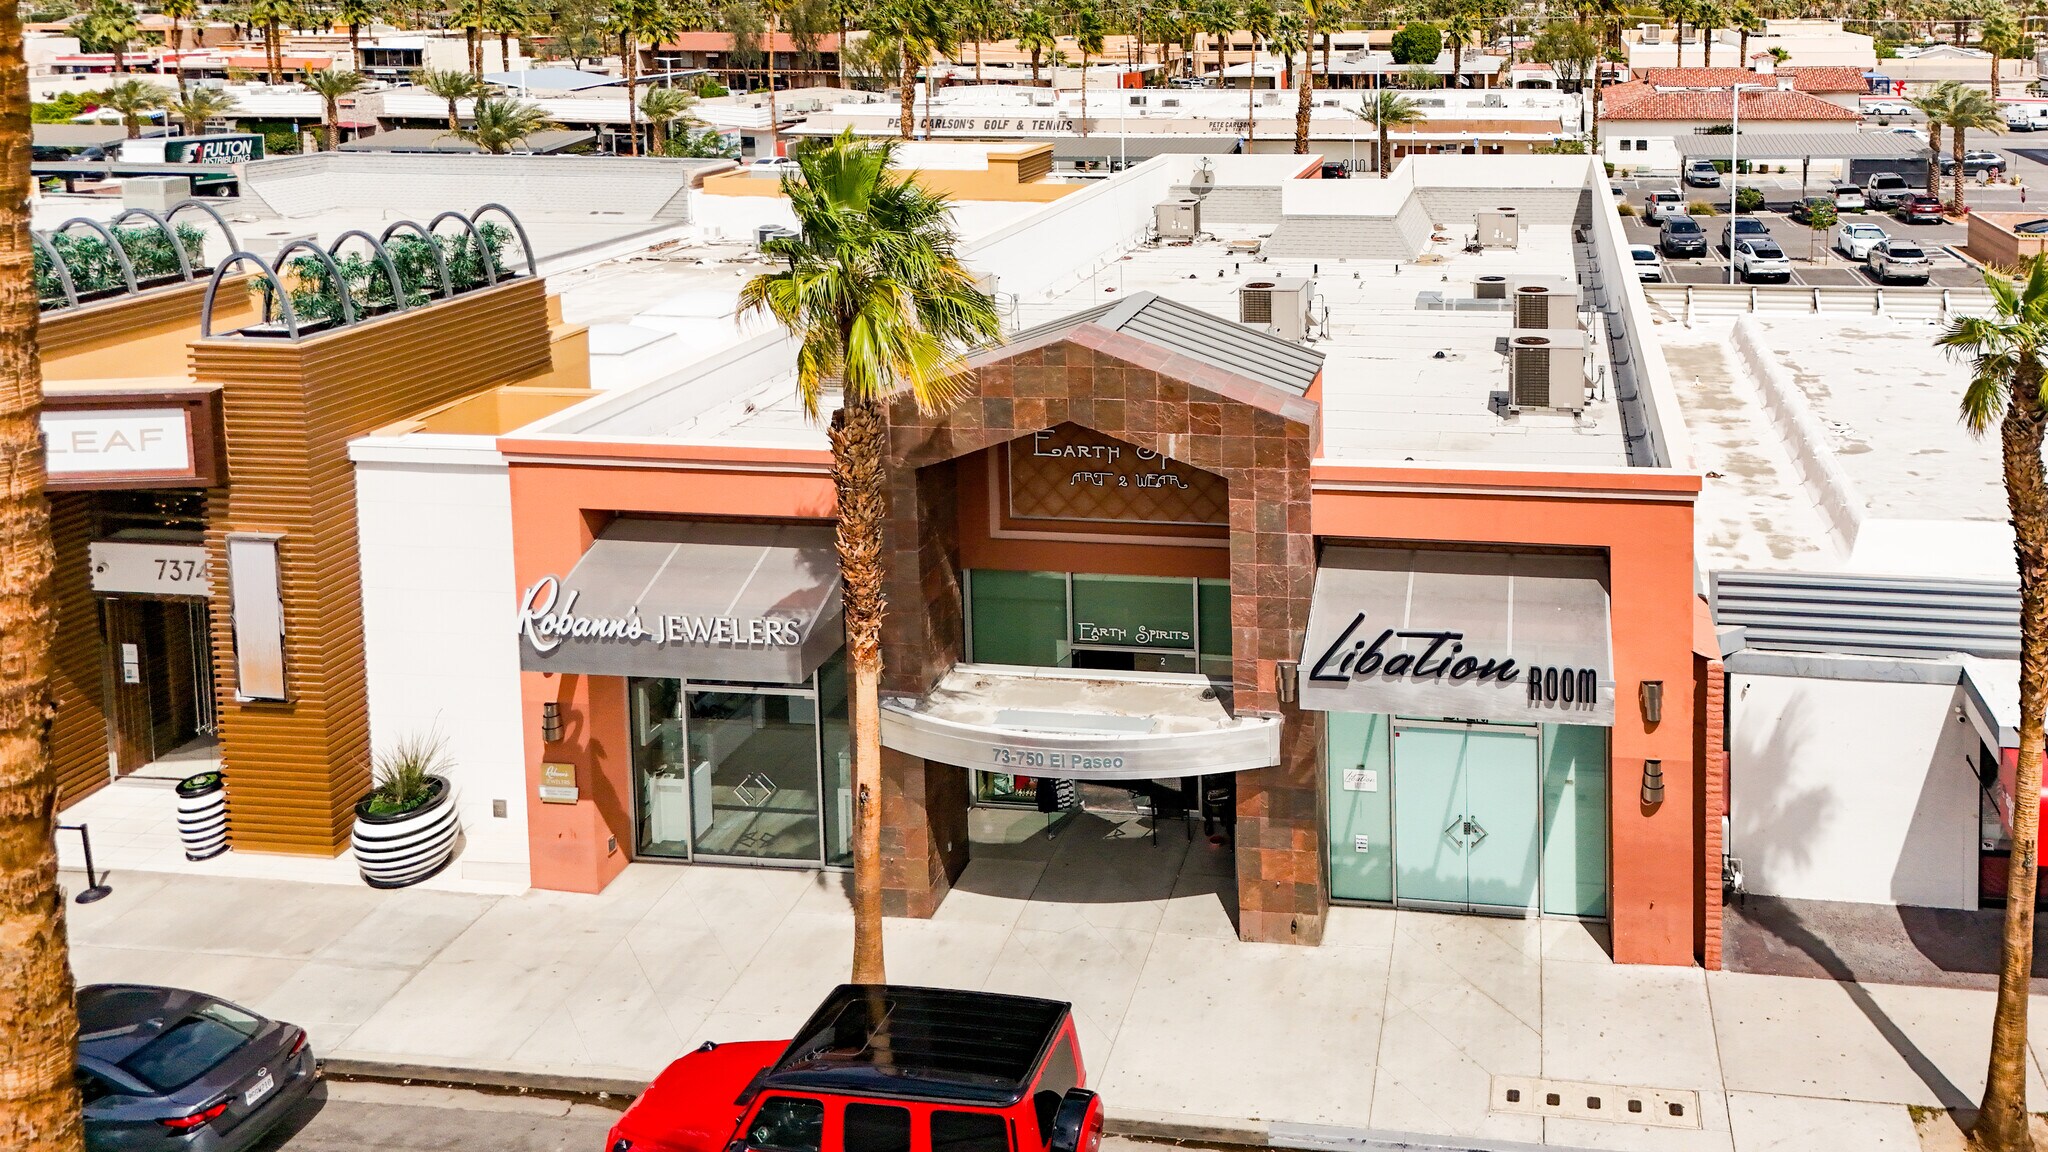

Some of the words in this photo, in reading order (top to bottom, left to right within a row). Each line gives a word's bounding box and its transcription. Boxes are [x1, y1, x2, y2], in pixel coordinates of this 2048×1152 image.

[920, 118, 976, 130] CARLSON'S
[983, 119, 1010, 130] GOLF
[1016, 120, 1024, 130] &
[1032, 120, 1073, 131] TENNIS
[1225, 121, 1257, 129] CARLSONS
[202, 140, 252, 158] FULTON
[202, 154, 251, 164] DISTRIBUTING
[1033, 429, 1120, 464] EARTH
[1070, 471, 1114, 486] ART
[1135, 473, 1189, 489] WEAR
[517, 575, 652, 652] Robann's
[656, 614, 801, 646] JEWELERS
[1077, 622, 1127, 642] EARTH
[1135, 625, 1190, 644] SPIRITS
[1160, 657, 1166, 666] 2
[1529, 664, 1598, 705] ROOM
[992, 748, 1044, 767] 73-750
[1049, 753, 1066, 768] El
[1071, 754, 1123, 769] Paseo
